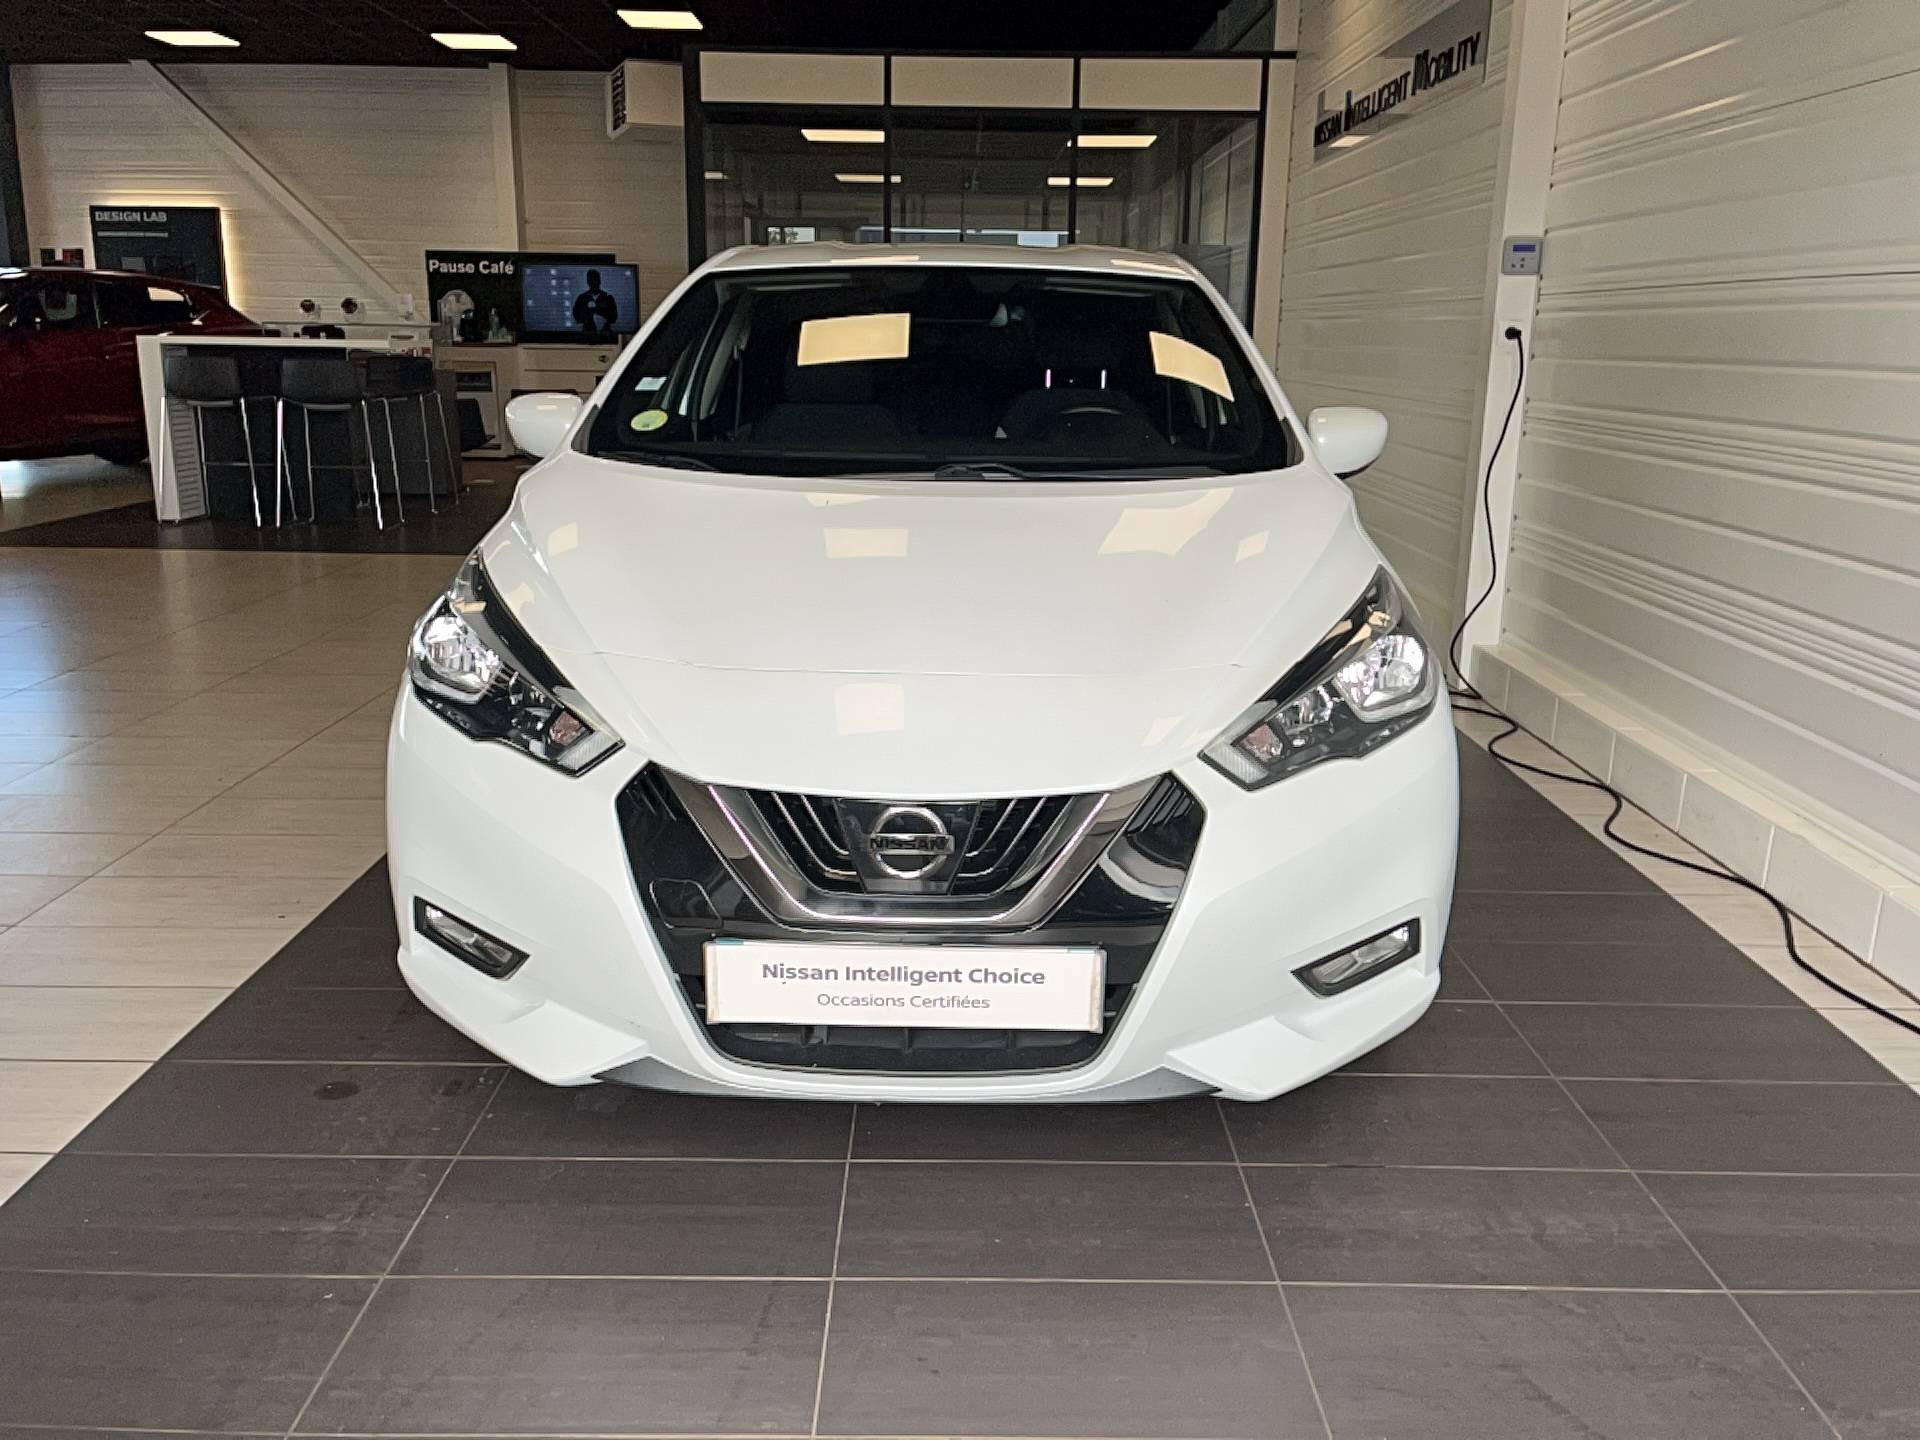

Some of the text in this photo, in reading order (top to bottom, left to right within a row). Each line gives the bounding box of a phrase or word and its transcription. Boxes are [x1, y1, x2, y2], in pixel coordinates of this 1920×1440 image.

[1344, 71, 1411, 131] INTELLIGENT
[1411, 32, 1481, 96] MOBILITY
[95, 211, 167, 221] DESIGN LAB
[429, 258, 514, 275] Pause Café
[870, 836, 947, 850] NISSAN
[762, 963, 1046, 986] Nissan Intelligent Choice
[817, 993, 991, 1009] Occasions Certifiées
